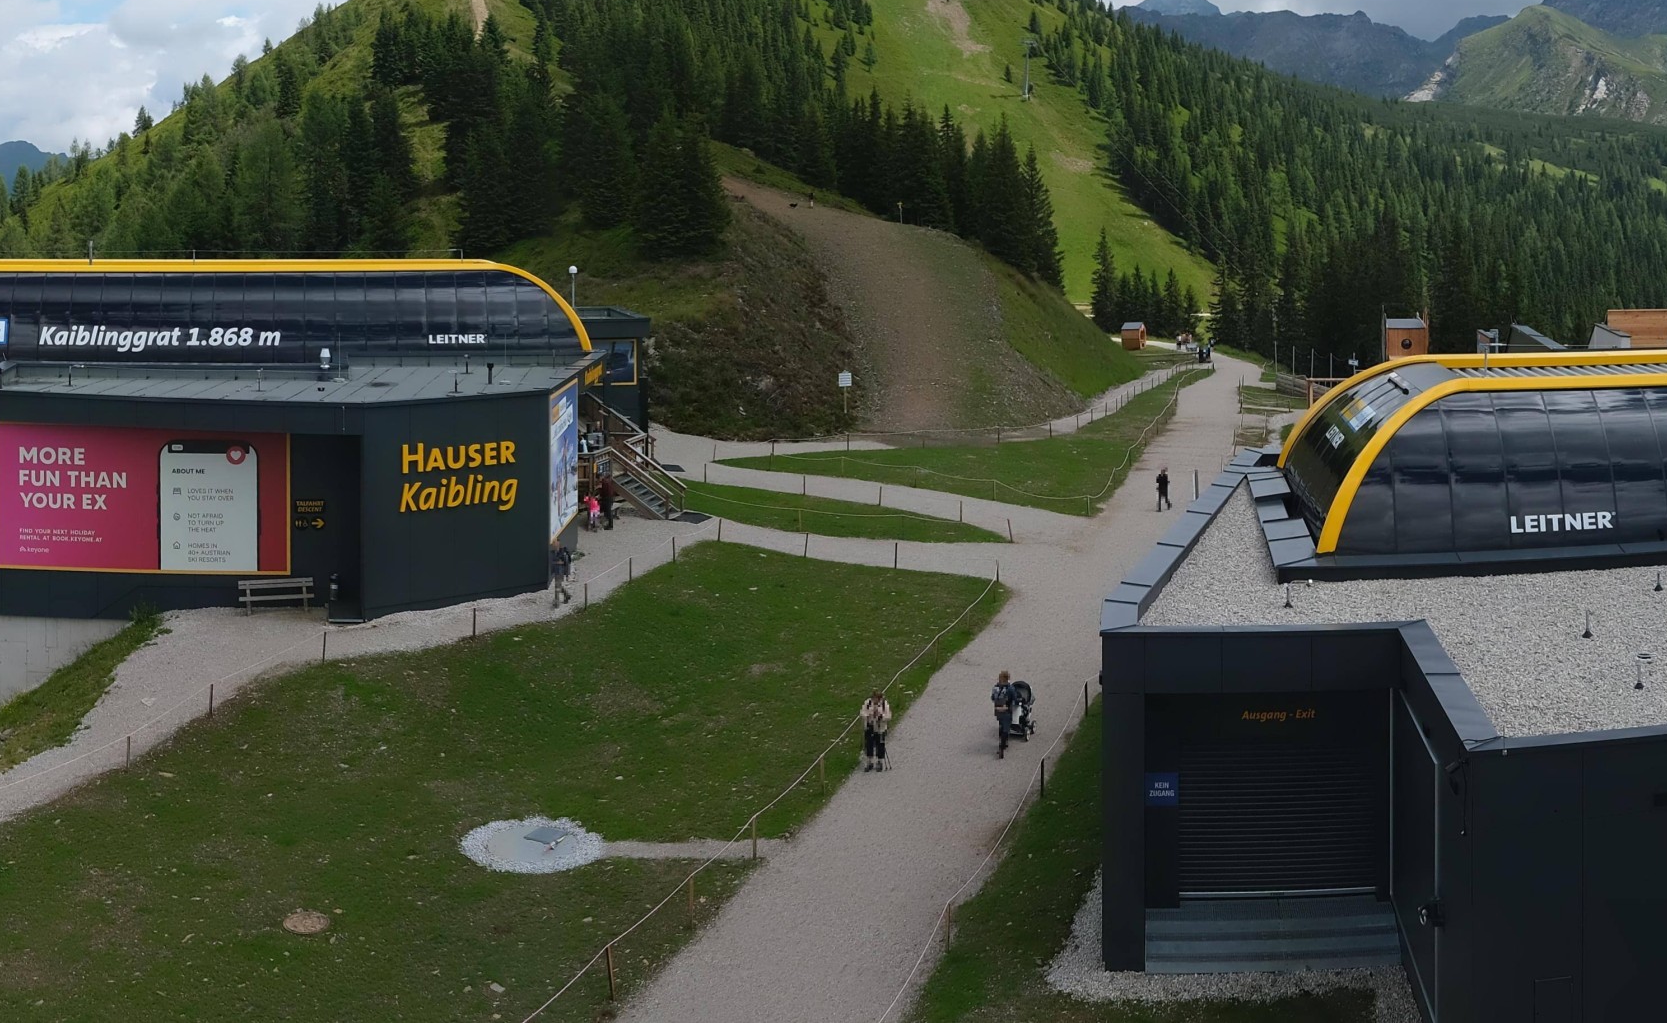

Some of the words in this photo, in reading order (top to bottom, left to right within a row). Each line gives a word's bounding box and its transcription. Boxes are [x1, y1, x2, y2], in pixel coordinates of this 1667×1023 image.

[39, 326, 181, 352] Kaiblinggrat
[186, 327, 253, 346] 1.868
[258, 330, 281, 346] m
[428, 334, 487, 344] LEITNER
[18, 446, 85, 465] MORE
[402, 441, 516, 474] HAUSER
[18, 469, 60, 487] FUN
[67, 471, 127, 488] THAN
[19, 492, 76, 509] YOUR
[82, 494, 107, 510] EX
[399, 474, 518, 512] Kaibling
[1510, 511, 1613, 533] LEITNER
[1241, 710, 1287, 722] Ausgang
[1295, 709, 1316, 719] Exit
[1149, 789, 1175, 797] ZUGANG
[1154, 781, 1169, 789] KEIN
